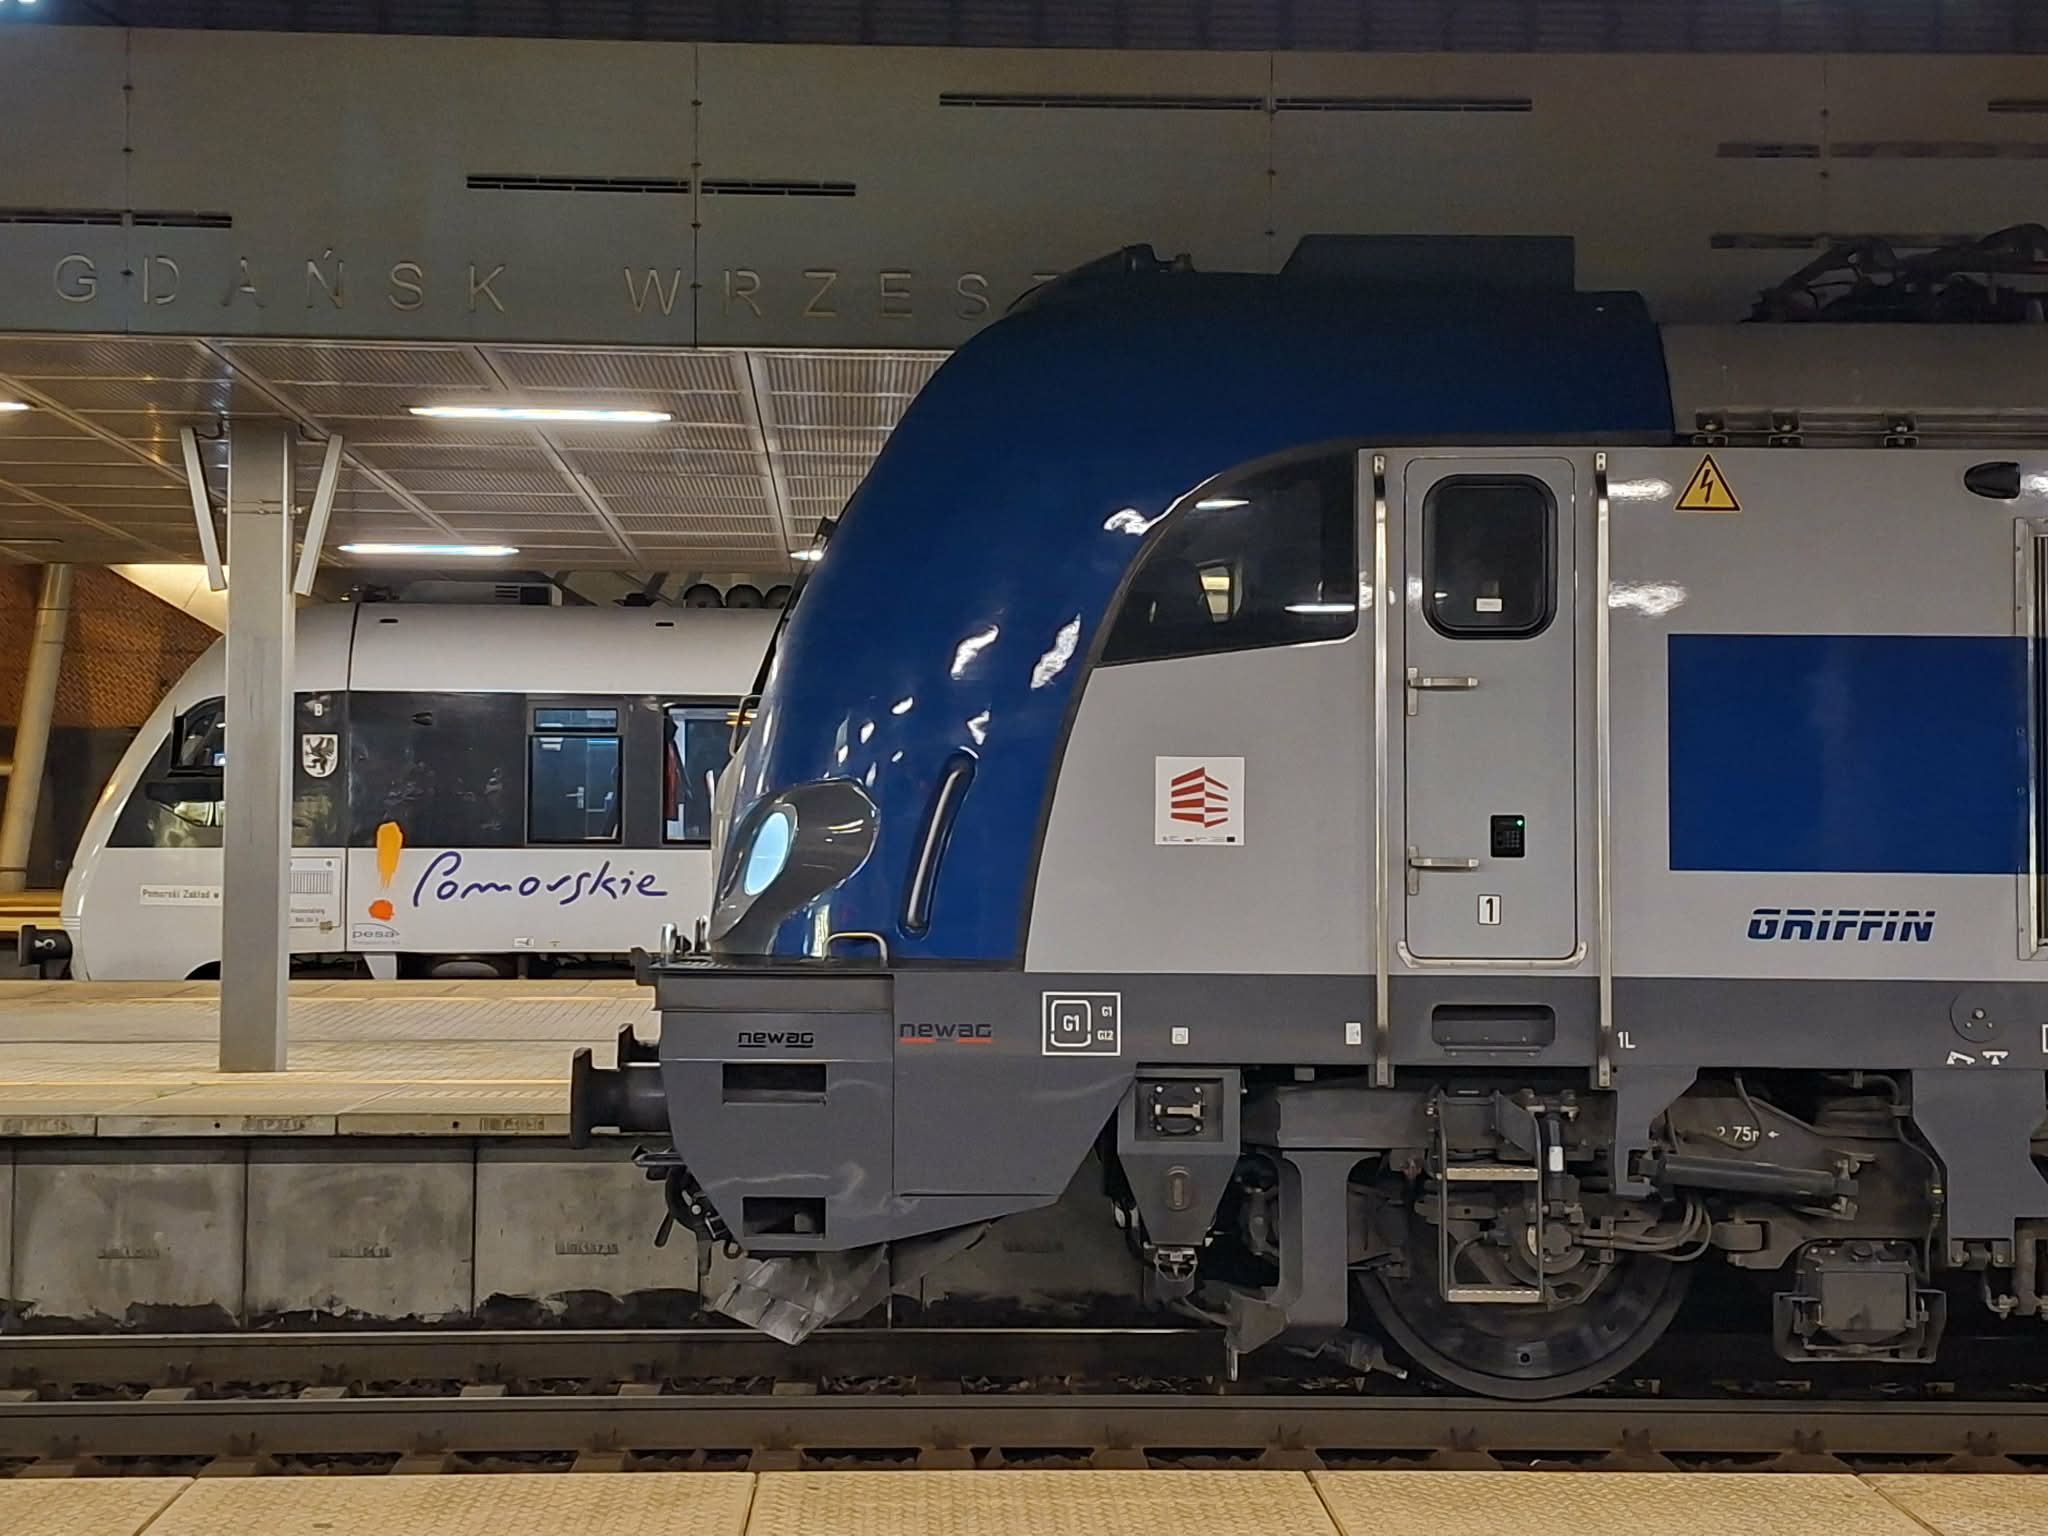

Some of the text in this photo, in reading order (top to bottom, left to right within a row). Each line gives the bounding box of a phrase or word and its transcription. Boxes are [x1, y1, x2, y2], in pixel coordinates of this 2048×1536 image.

[53, 247, 1059, 320] GDAŃSK WRZES
[412, 851, 668, 907] Pomorskie
[1486, 897, 1494, 922] 1
[352, 930, 396, 939] pesa
[1063, 1015, 1080, 1032] G1
[1617, 1031, 1636, 1049] 1L
